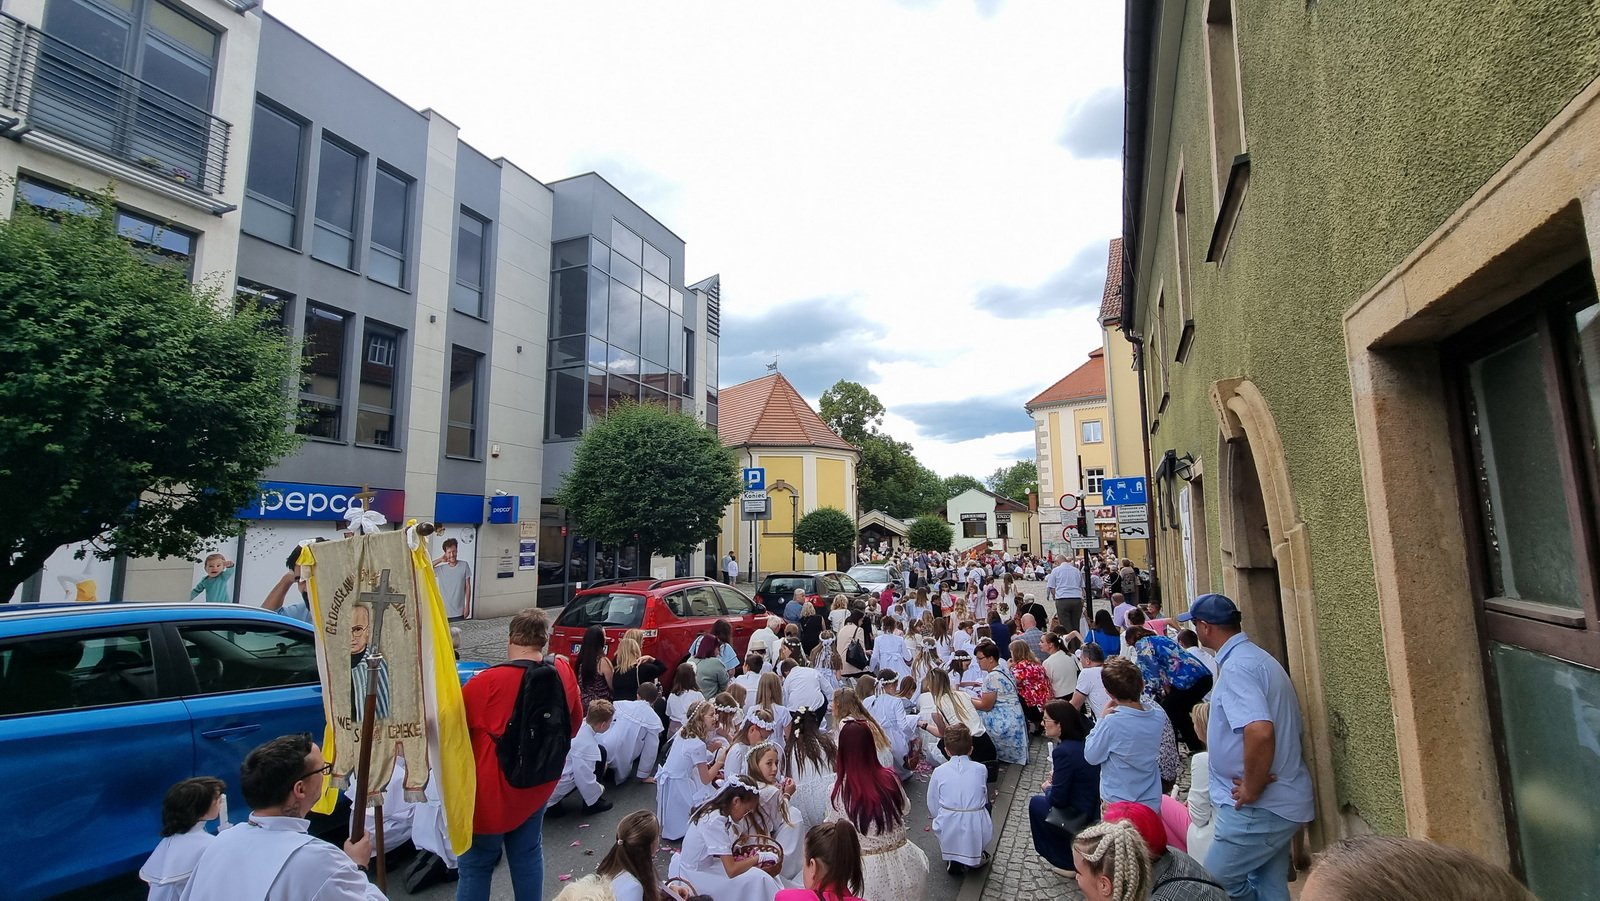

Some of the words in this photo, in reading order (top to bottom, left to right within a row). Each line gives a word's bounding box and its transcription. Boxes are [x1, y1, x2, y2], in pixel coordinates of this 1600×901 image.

[749, 471, 760, 488] P
[744, 491, 765, 499] Koniec
[260, 491, 364, 517] pepco
